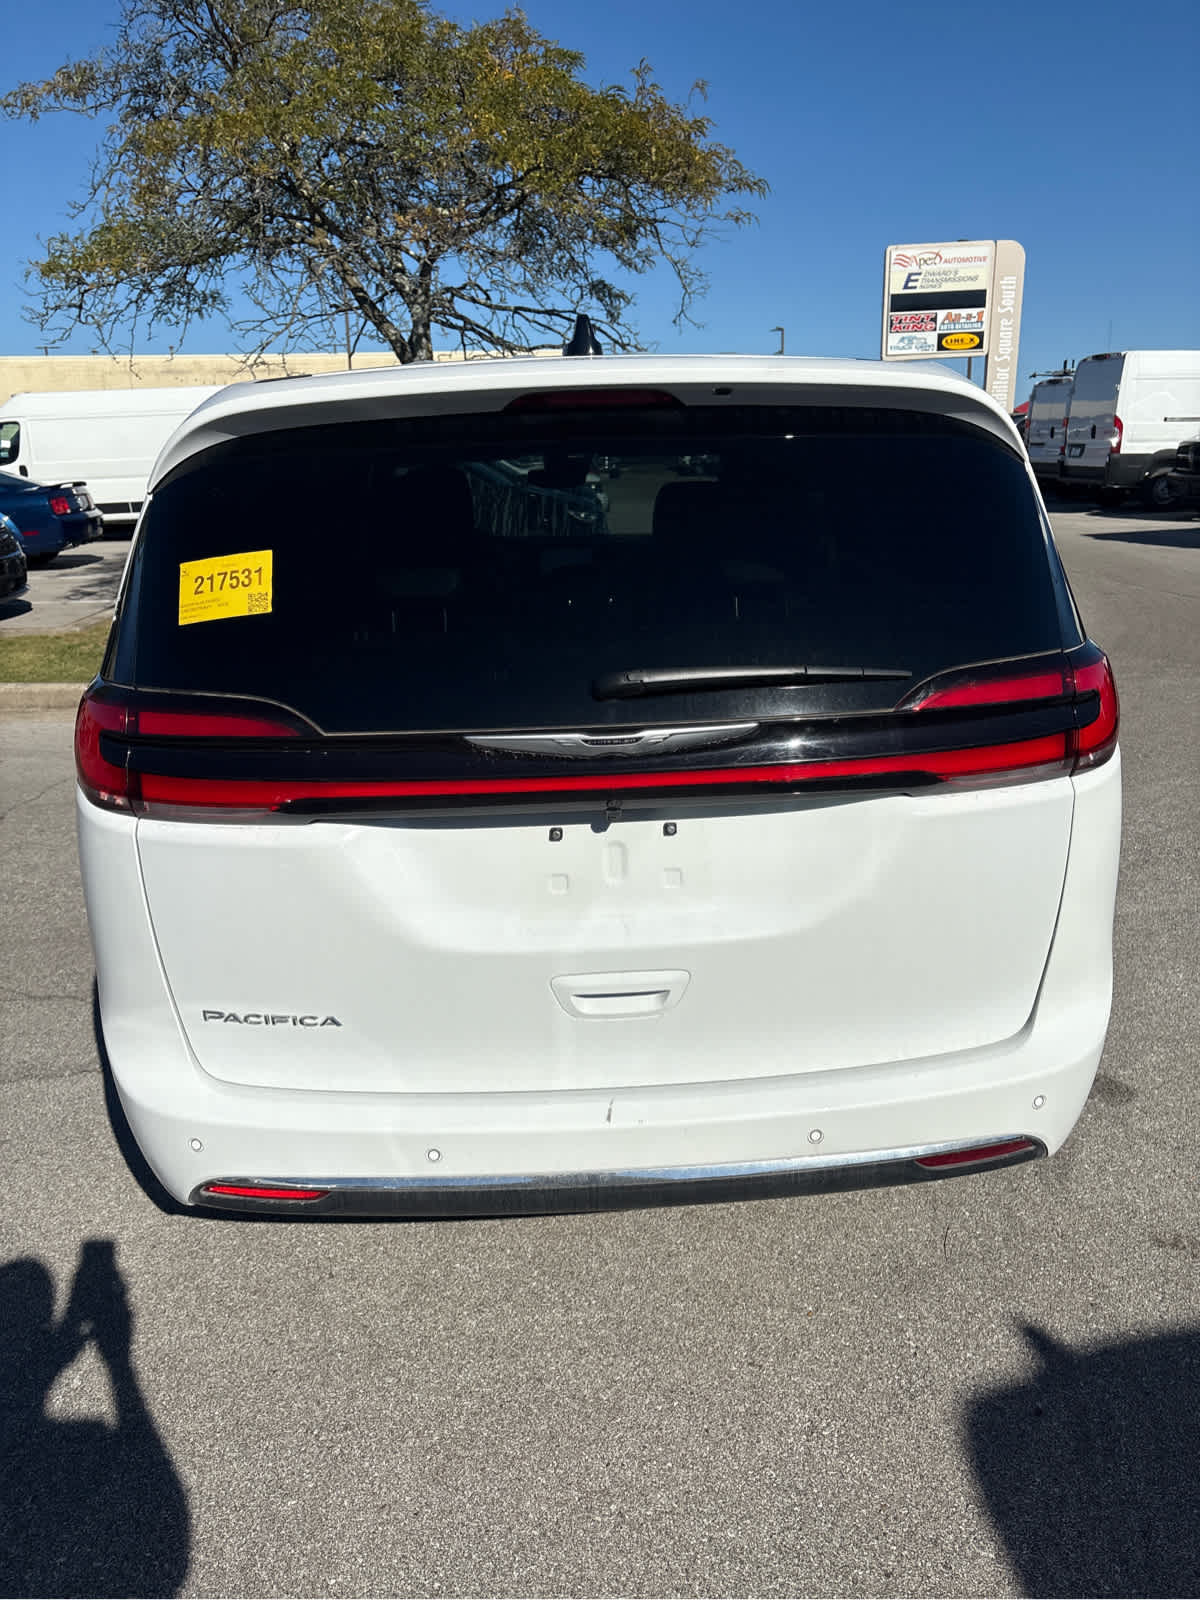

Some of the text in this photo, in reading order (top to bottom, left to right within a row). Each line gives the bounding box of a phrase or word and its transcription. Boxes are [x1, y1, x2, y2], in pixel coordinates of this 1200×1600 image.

[943, 256, 988, 264] AUTOMOTIVE
[997, 275, 1017, 313] South
[891, 322, 936, 332] KING
[892, 313, 936, 323] TINT
[994, 318, 1014, 362] Square
[193, 566, 264, 596] 217531
[202, 1009, 343, 1027] PACIFICA
